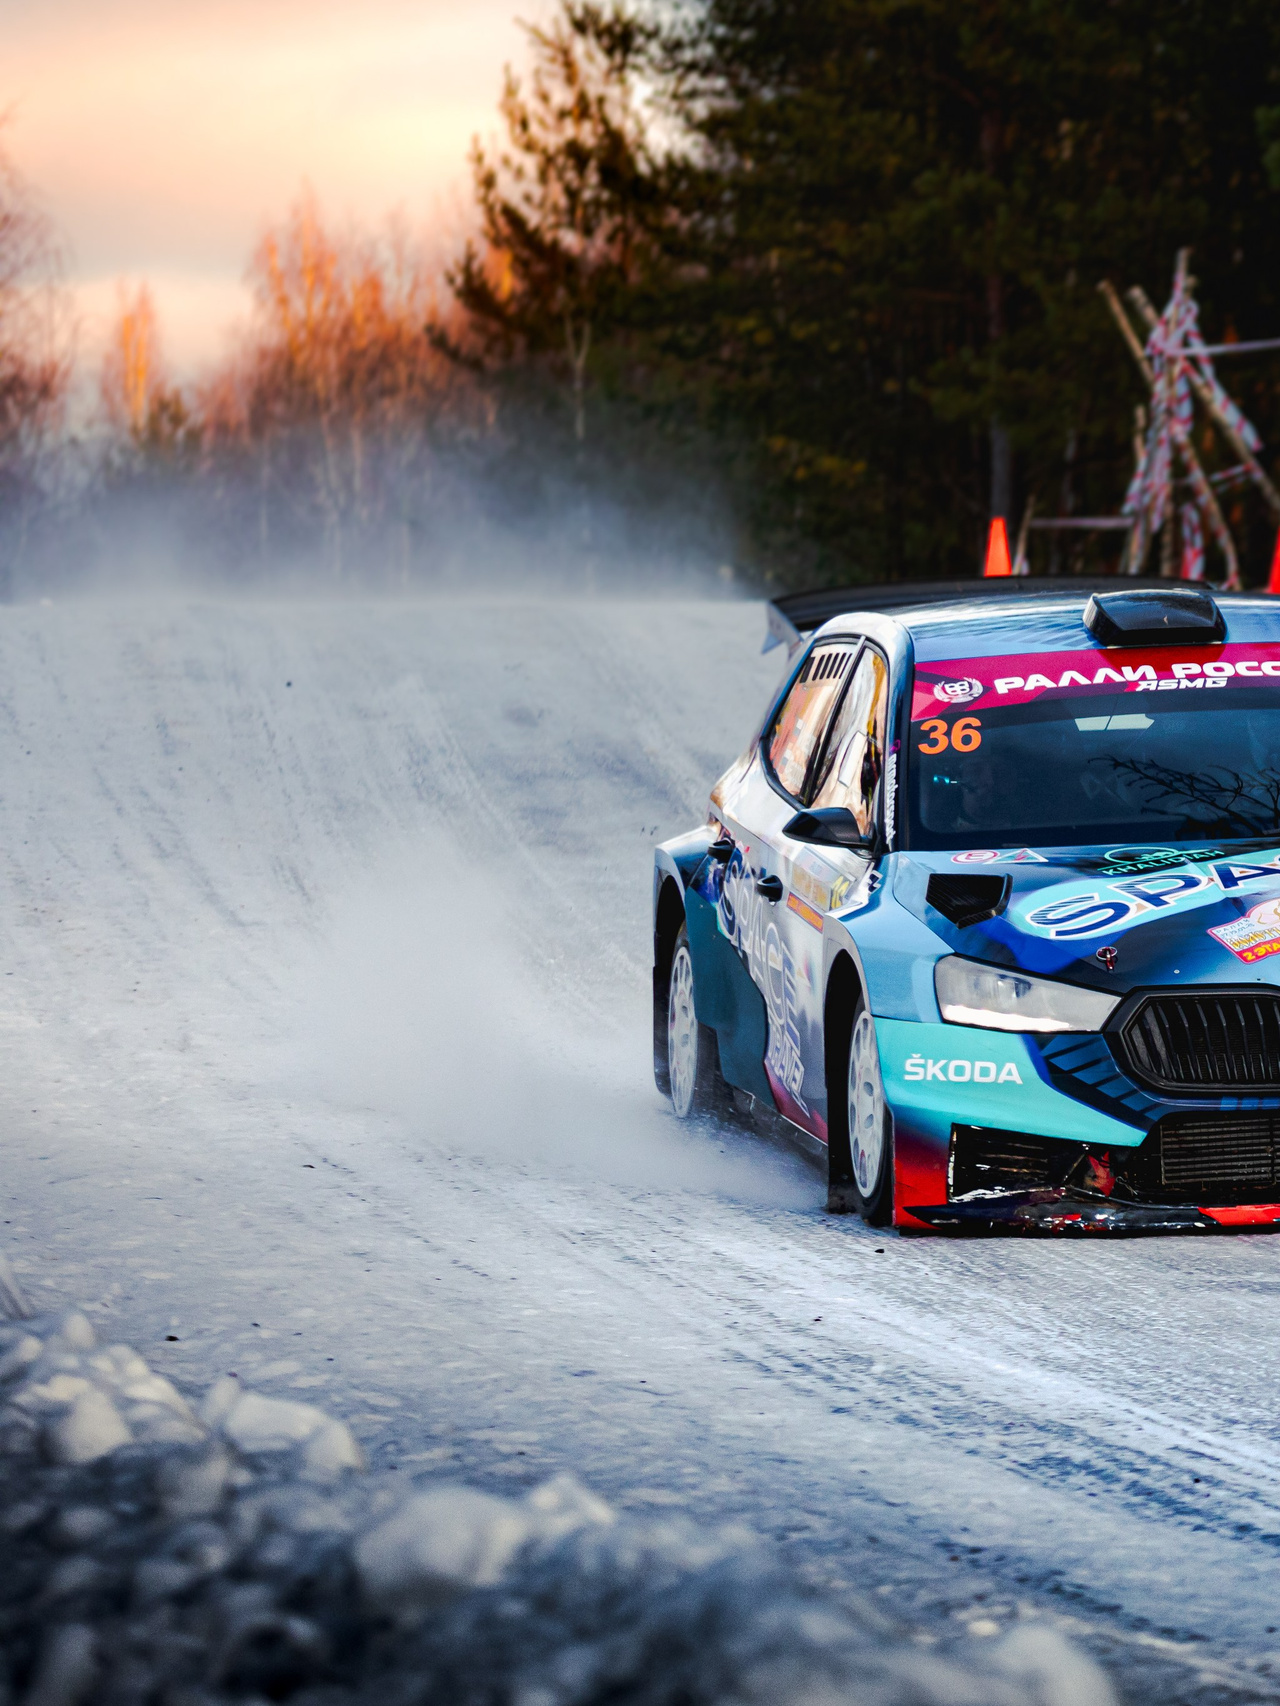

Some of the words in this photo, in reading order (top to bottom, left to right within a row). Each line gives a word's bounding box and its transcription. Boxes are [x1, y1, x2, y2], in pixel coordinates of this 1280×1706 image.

[994, 664, 1157, 694] РАЛЛИ
[918, 717, 982, 754] 36
[1102, 850, 1225, 876] KHALIDIAH
[1243, 951, 1255, 961] 2
[905, 1053, 1023, 1084] ŠKODA
